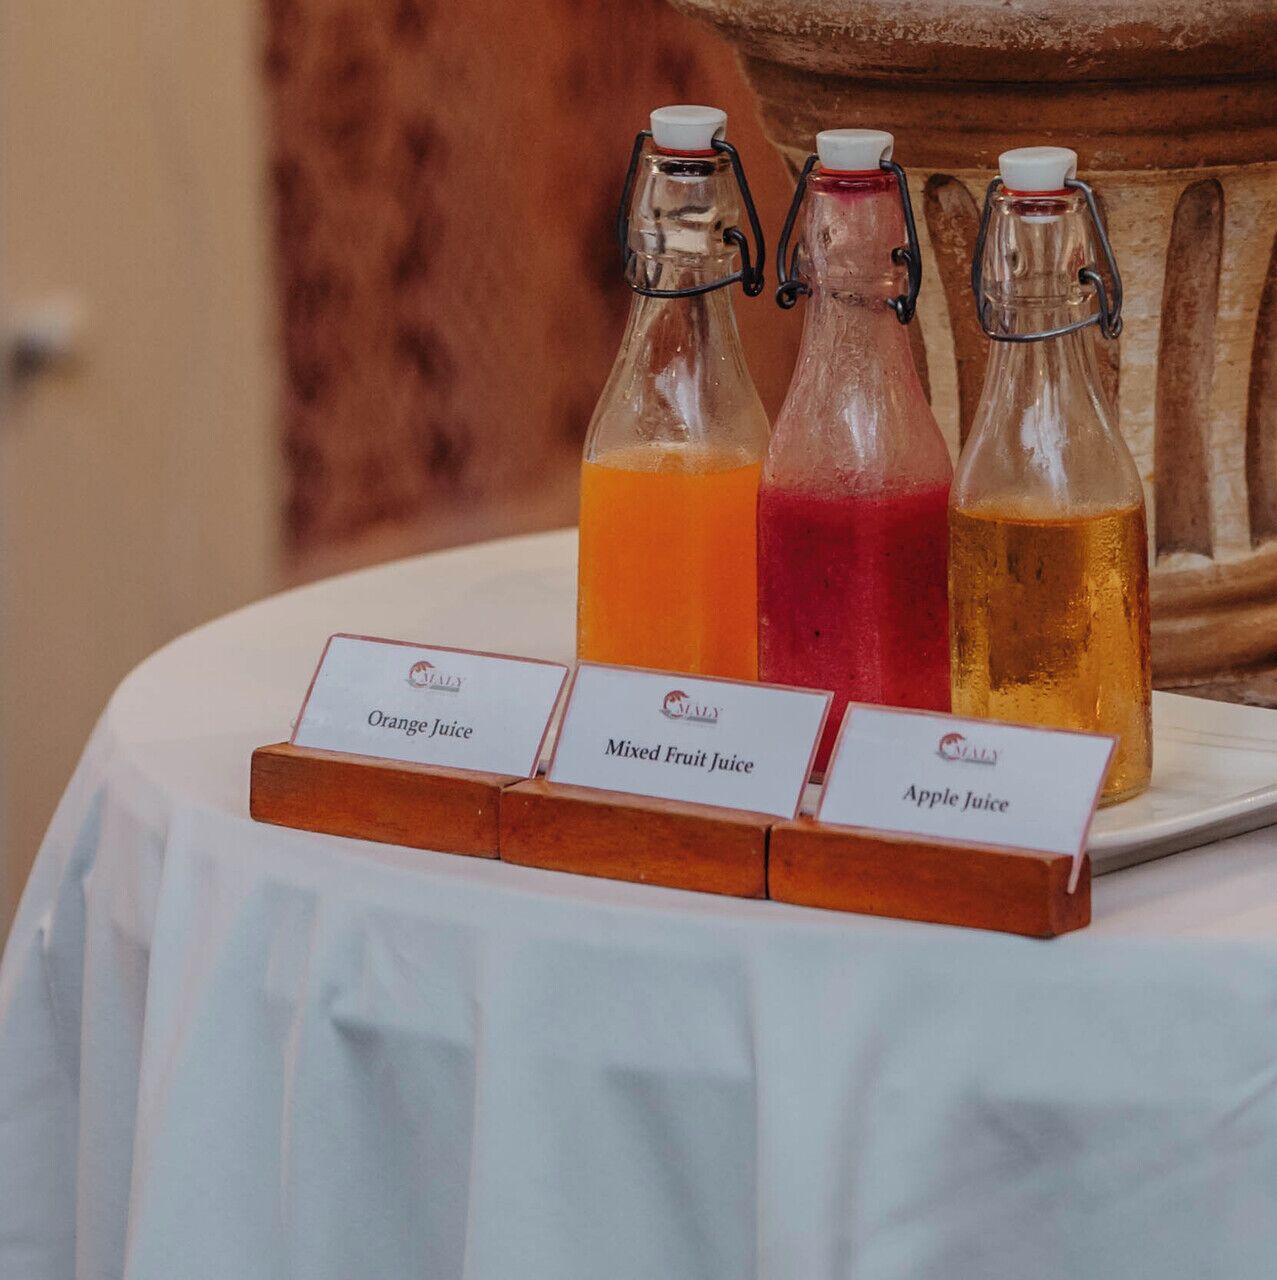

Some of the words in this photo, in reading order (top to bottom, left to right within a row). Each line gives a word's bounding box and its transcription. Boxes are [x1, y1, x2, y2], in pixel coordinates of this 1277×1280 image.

[367, 709, 428, 737] Orange
[428, 718, 474, 739] Juice
[604, 739, 661, 761] Mixed
[664, 746, 707, 768] Fruit
[708, 753, 754, 774] Juice
[903, 784, 959, 809] Apple
[961, 791, 1009, 813] Juice
